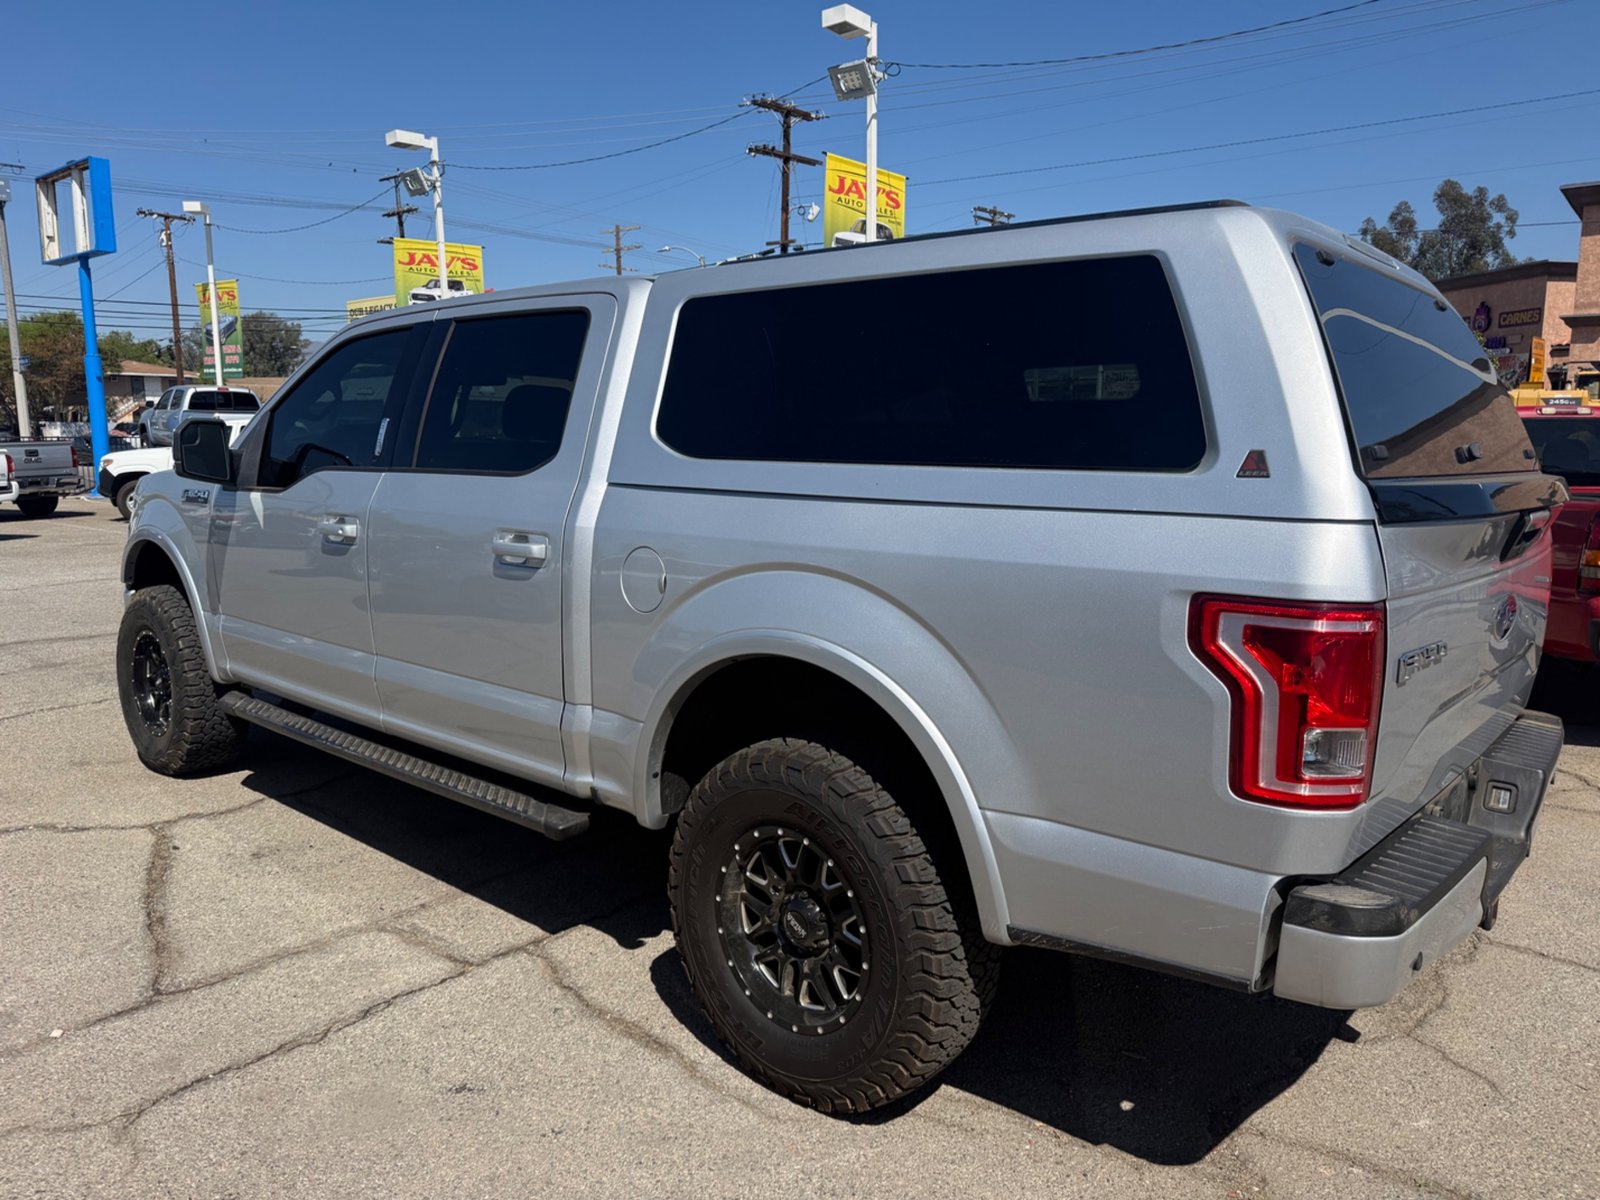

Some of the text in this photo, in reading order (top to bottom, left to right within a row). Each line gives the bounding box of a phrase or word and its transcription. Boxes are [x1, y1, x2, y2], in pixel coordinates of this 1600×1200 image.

[836, 196, 863, 208] AUTO
[408, 266, 437, 274] AUTO
[1500, 312, 1539, 325] CARNES
